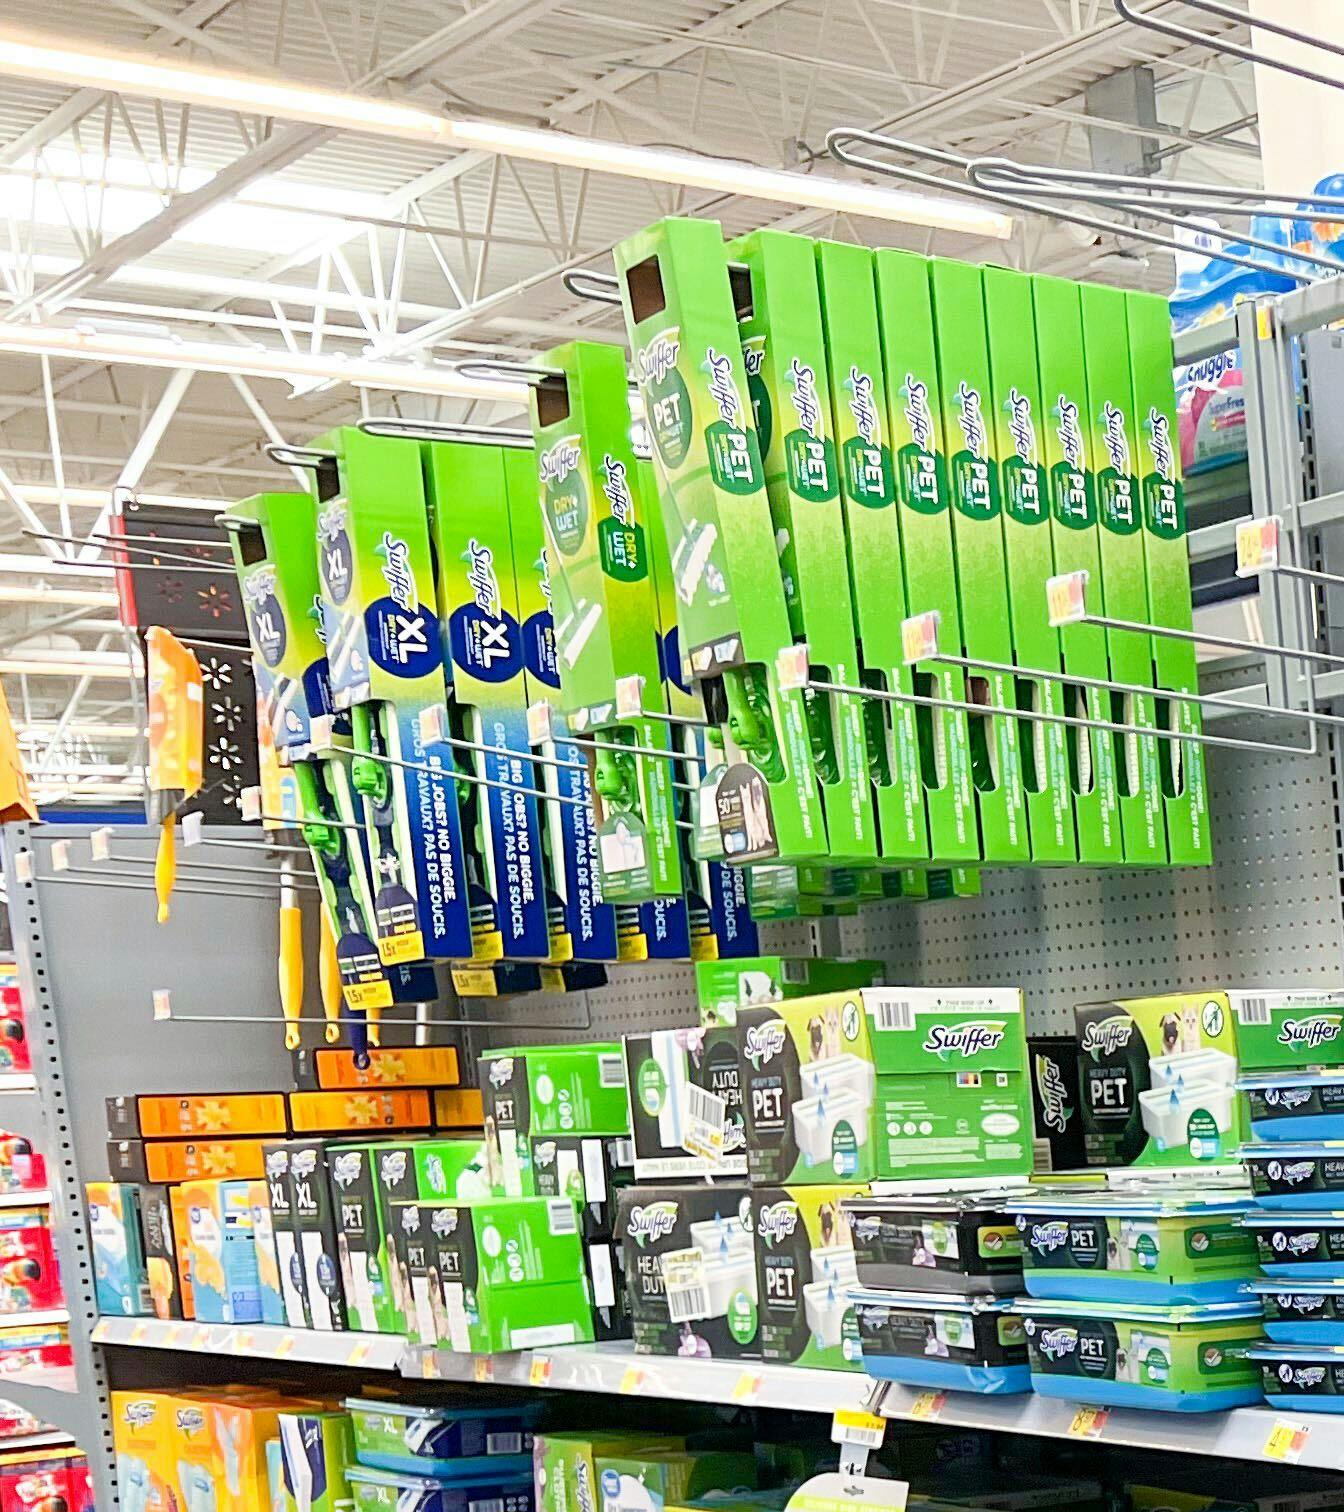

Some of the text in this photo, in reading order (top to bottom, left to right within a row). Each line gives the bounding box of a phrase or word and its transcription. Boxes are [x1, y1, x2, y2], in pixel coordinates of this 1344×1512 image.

[639, 327, 680, 388] Swiffer
[708, 347, 738, 429] Swiffer
[1010, 388, 1039, 468] Swiffer
[729, 433, 753, 483] PET
[917, 455, 938, 505] PET
[1114, 479, 1133, 526] PET
[329, 554, 346, 579] XL
[613, 533, 626, 567] WET
[397, 615, 428, 663] XL
[433, 785, 455, 903] JOBS? NO BIGGIE.
[517, 831, 534, 904] NO BIGGIE.
[423, 833, 445, 939] PAS SOUCIS.
[577, 867, 588, 885] DE
[1082, 1015, 1132, 1067] Swiffer
[753, 1089, 783, 1119] PET
